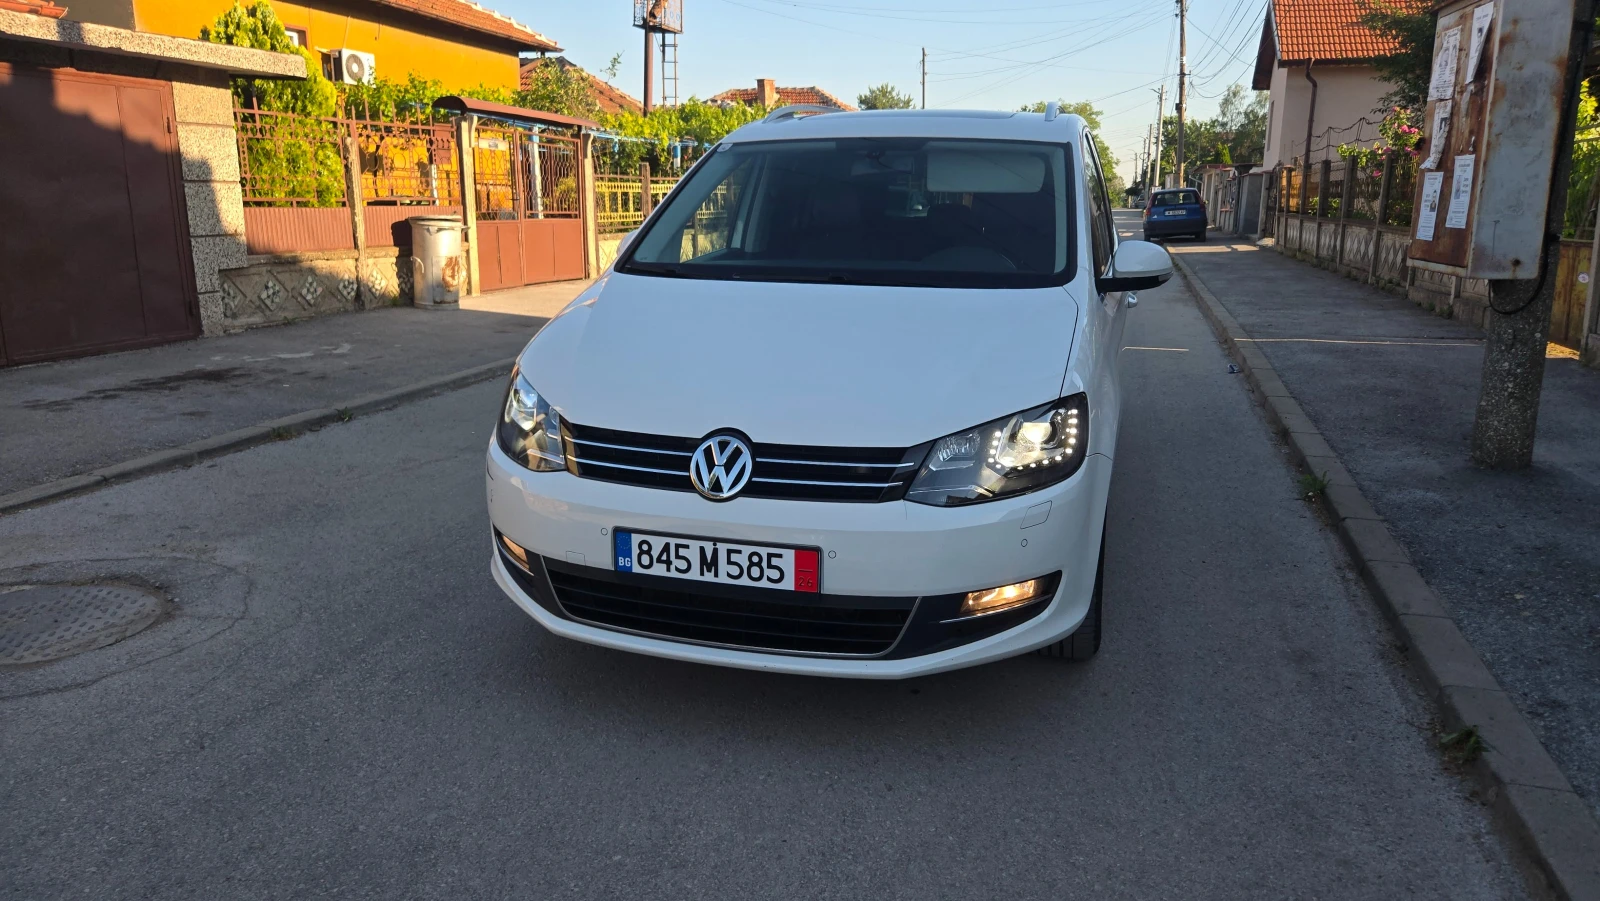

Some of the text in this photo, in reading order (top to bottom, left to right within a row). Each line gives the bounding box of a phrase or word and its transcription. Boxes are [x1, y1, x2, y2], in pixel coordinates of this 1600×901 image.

[690, 435, 752, 499] VW
[618, 556, 631, 567] BG
[636, 539, 785, 584] 845 M 585
[798, 576, 813, 587] 26
